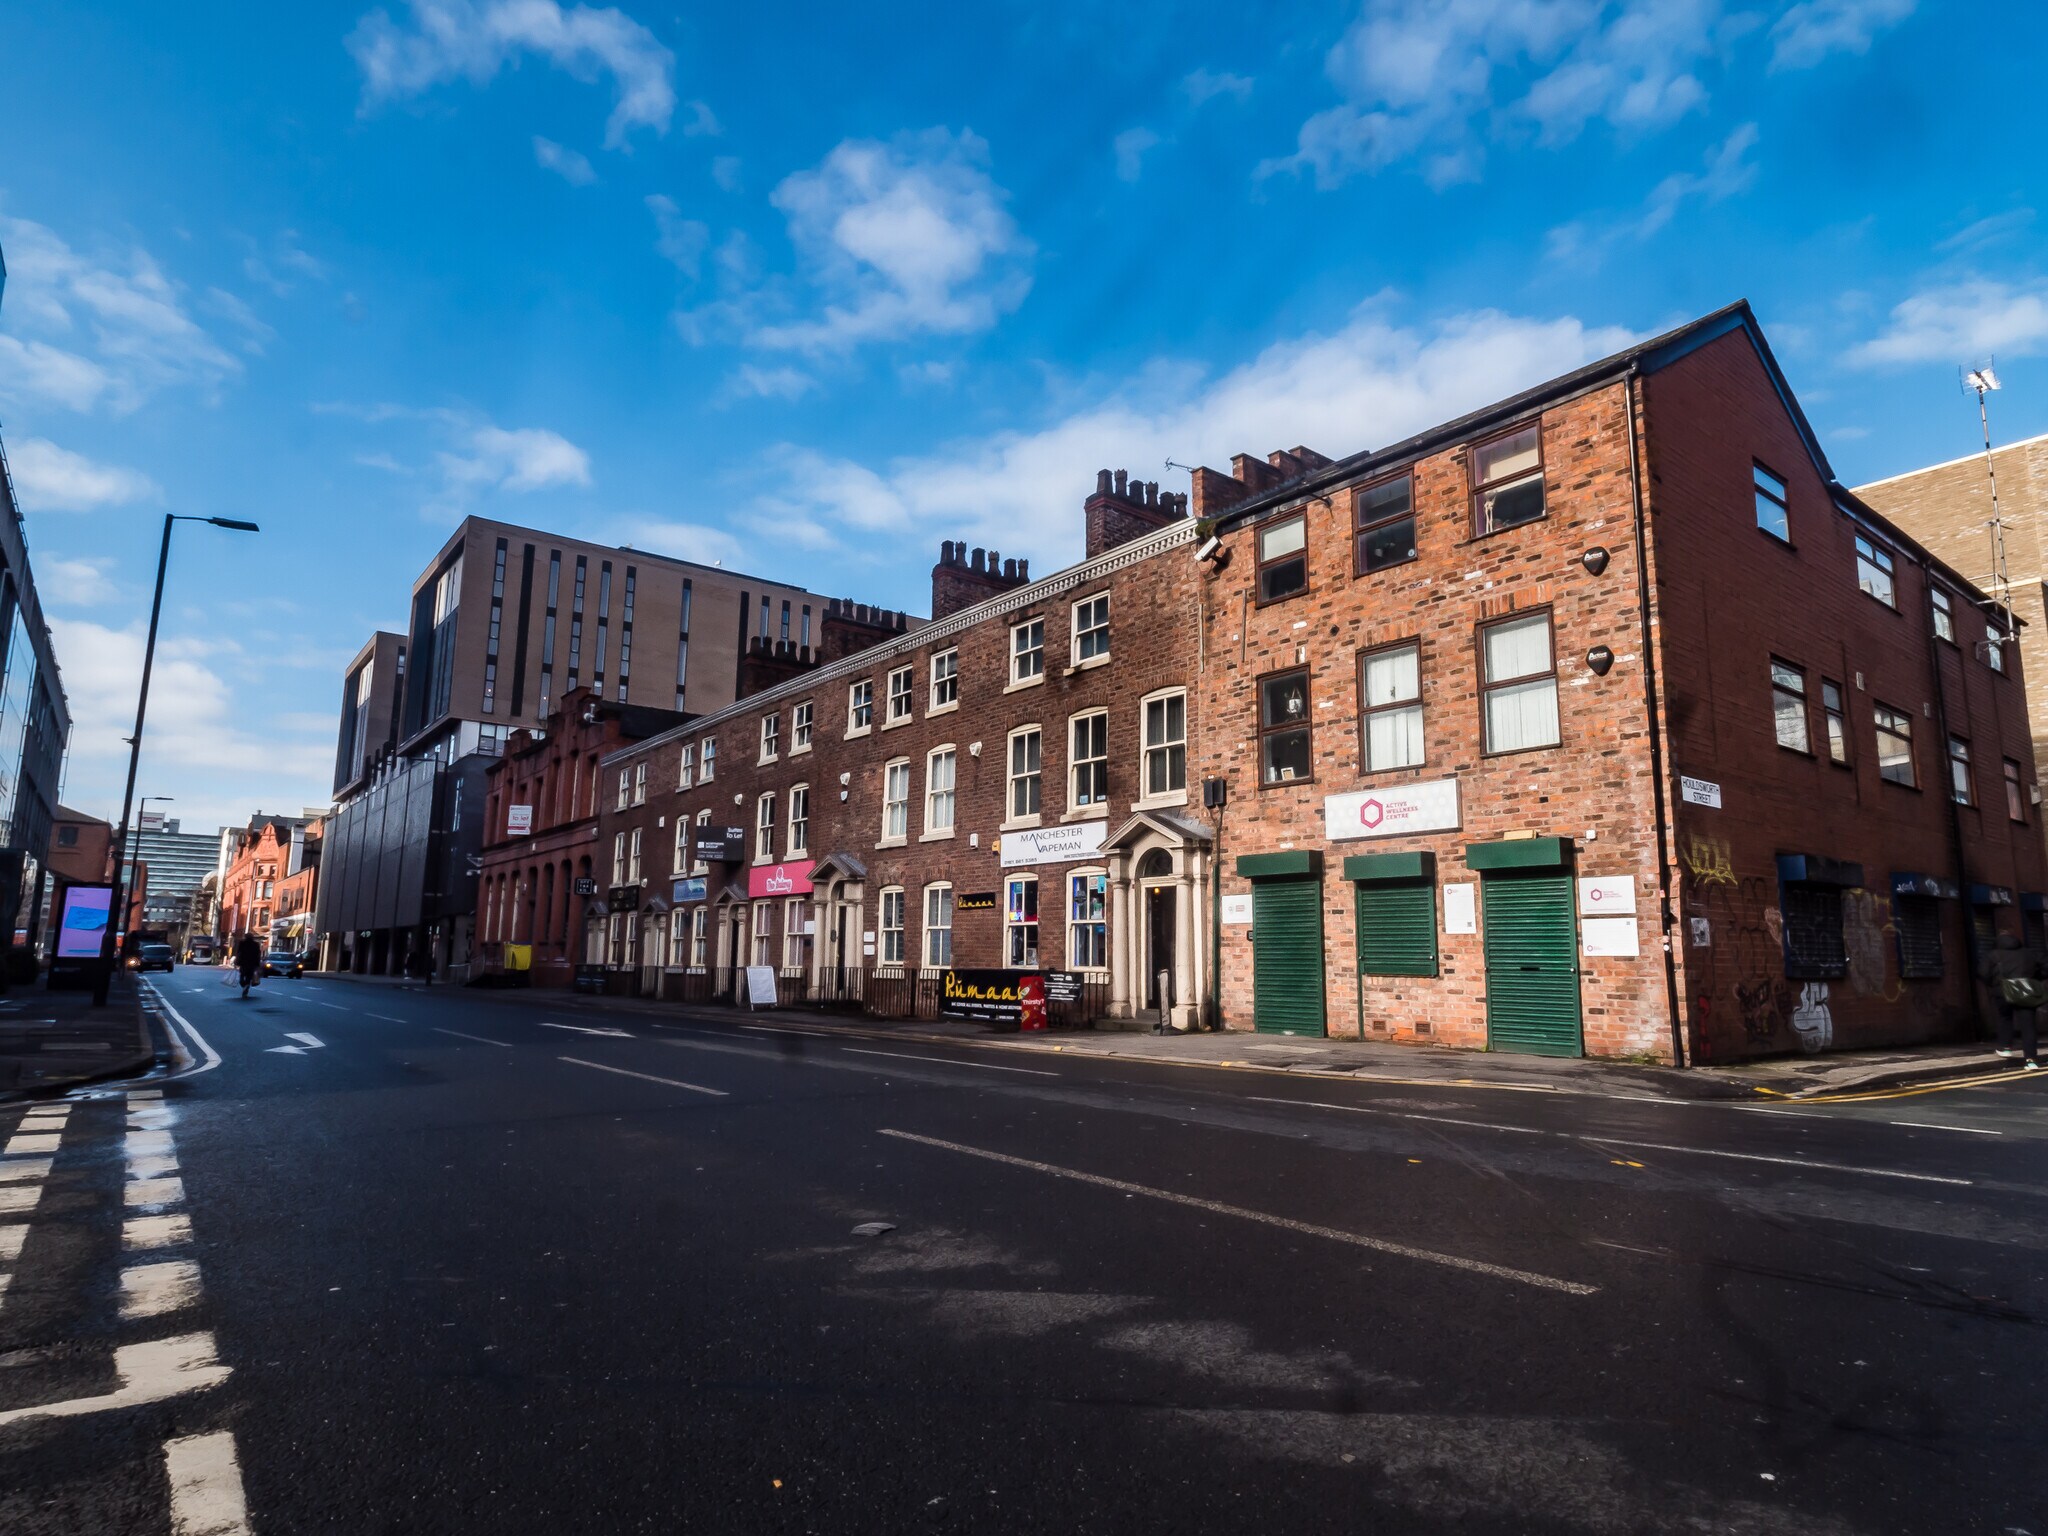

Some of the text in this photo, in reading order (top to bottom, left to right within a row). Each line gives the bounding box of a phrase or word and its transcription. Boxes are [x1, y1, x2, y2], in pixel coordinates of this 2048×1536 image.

[1682, 777, 1720, 794] HOULDSWORTH
[1693, 791, 1711, 803] STREET
[1385, 806, 1419, 814] WELLNESS
[1020, 828, 1083, 842] MANCHESTER
[1037, 842, 1082, 853] VAPEMAN
